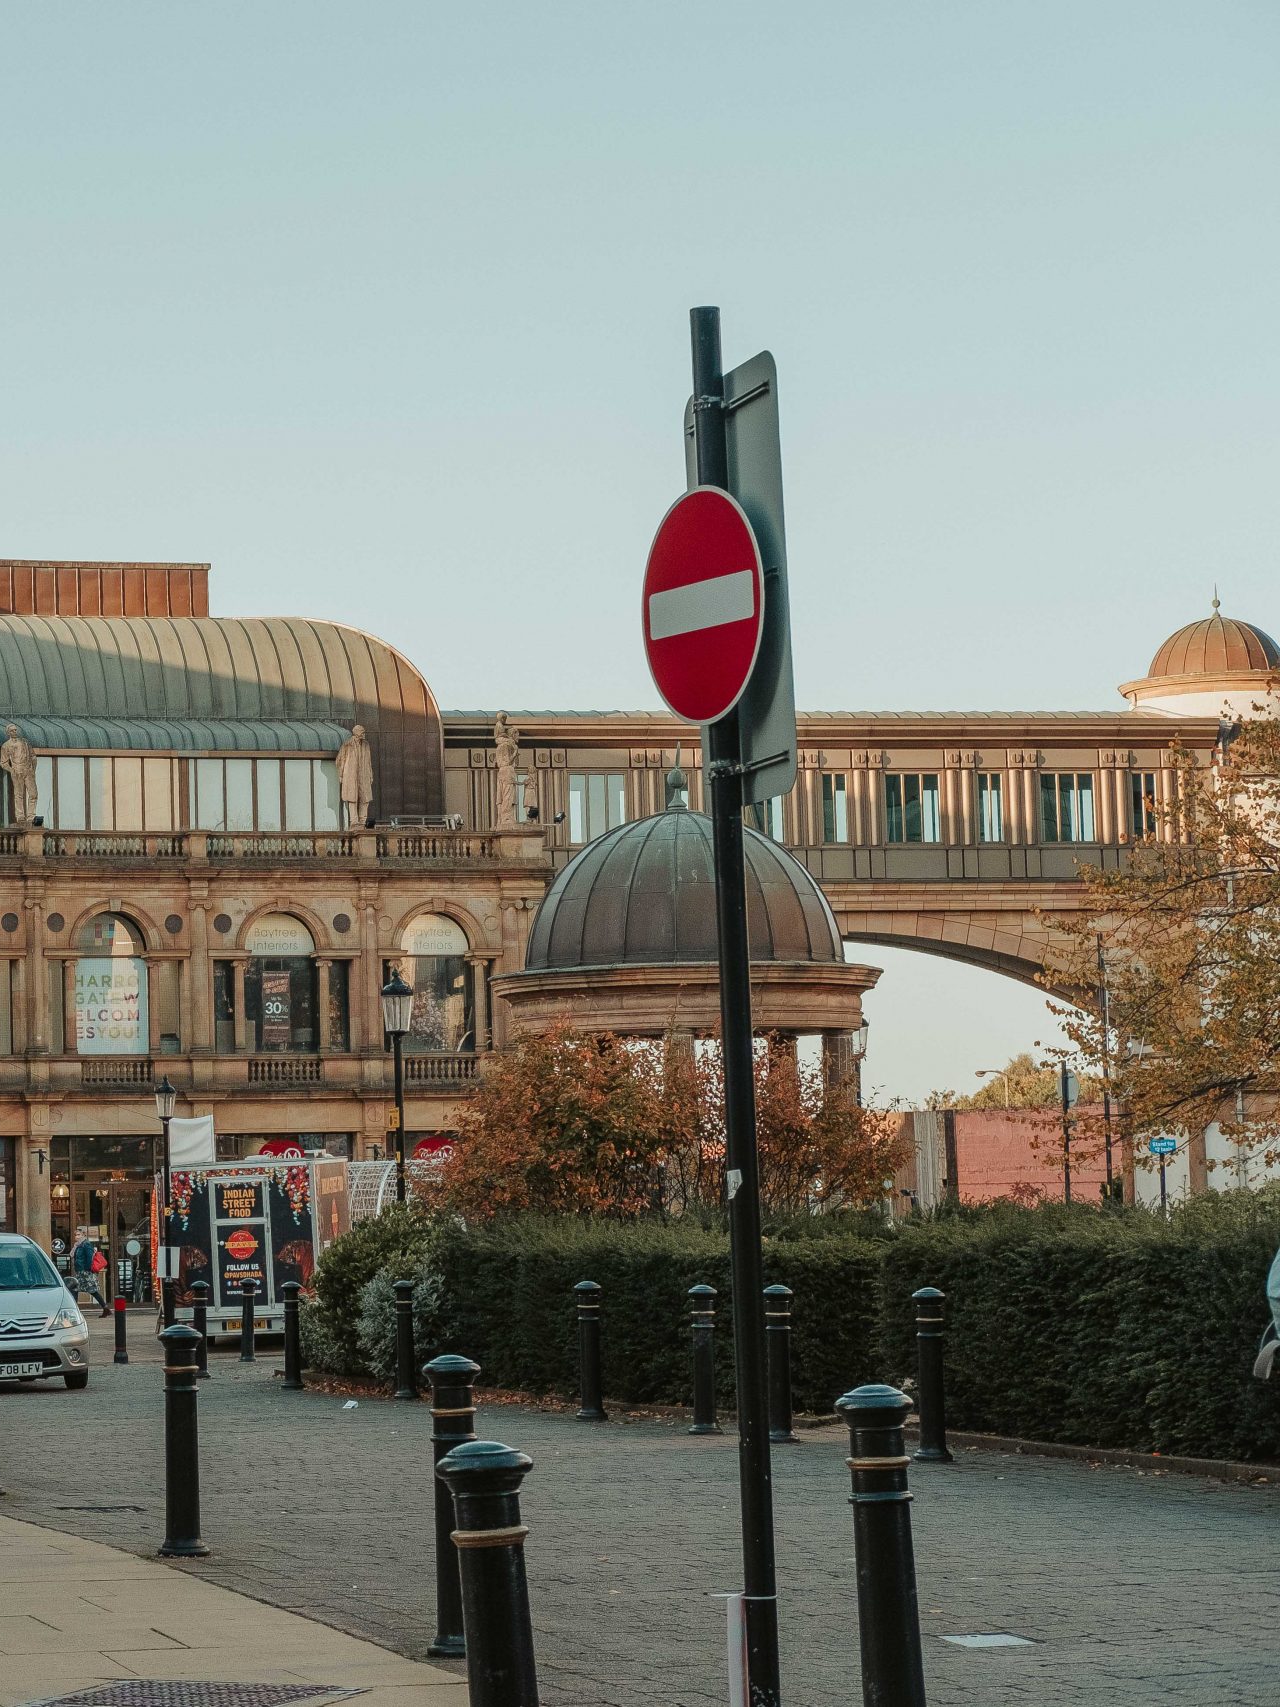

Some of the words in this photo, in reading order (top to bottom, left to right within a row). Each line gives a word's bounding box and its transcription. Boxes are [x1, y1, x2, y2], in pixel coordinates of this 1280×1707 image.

[265, 1002, 288, 1014] 30%
[223, 1189, 255, 1199] INDIAN
[223, 1199, 255, 1209] STREET
[229, 1209, 251, 1217] FOOD
[55, 1241, 61, 1249] 2
[21, 1364, 40, 1374] LFV
